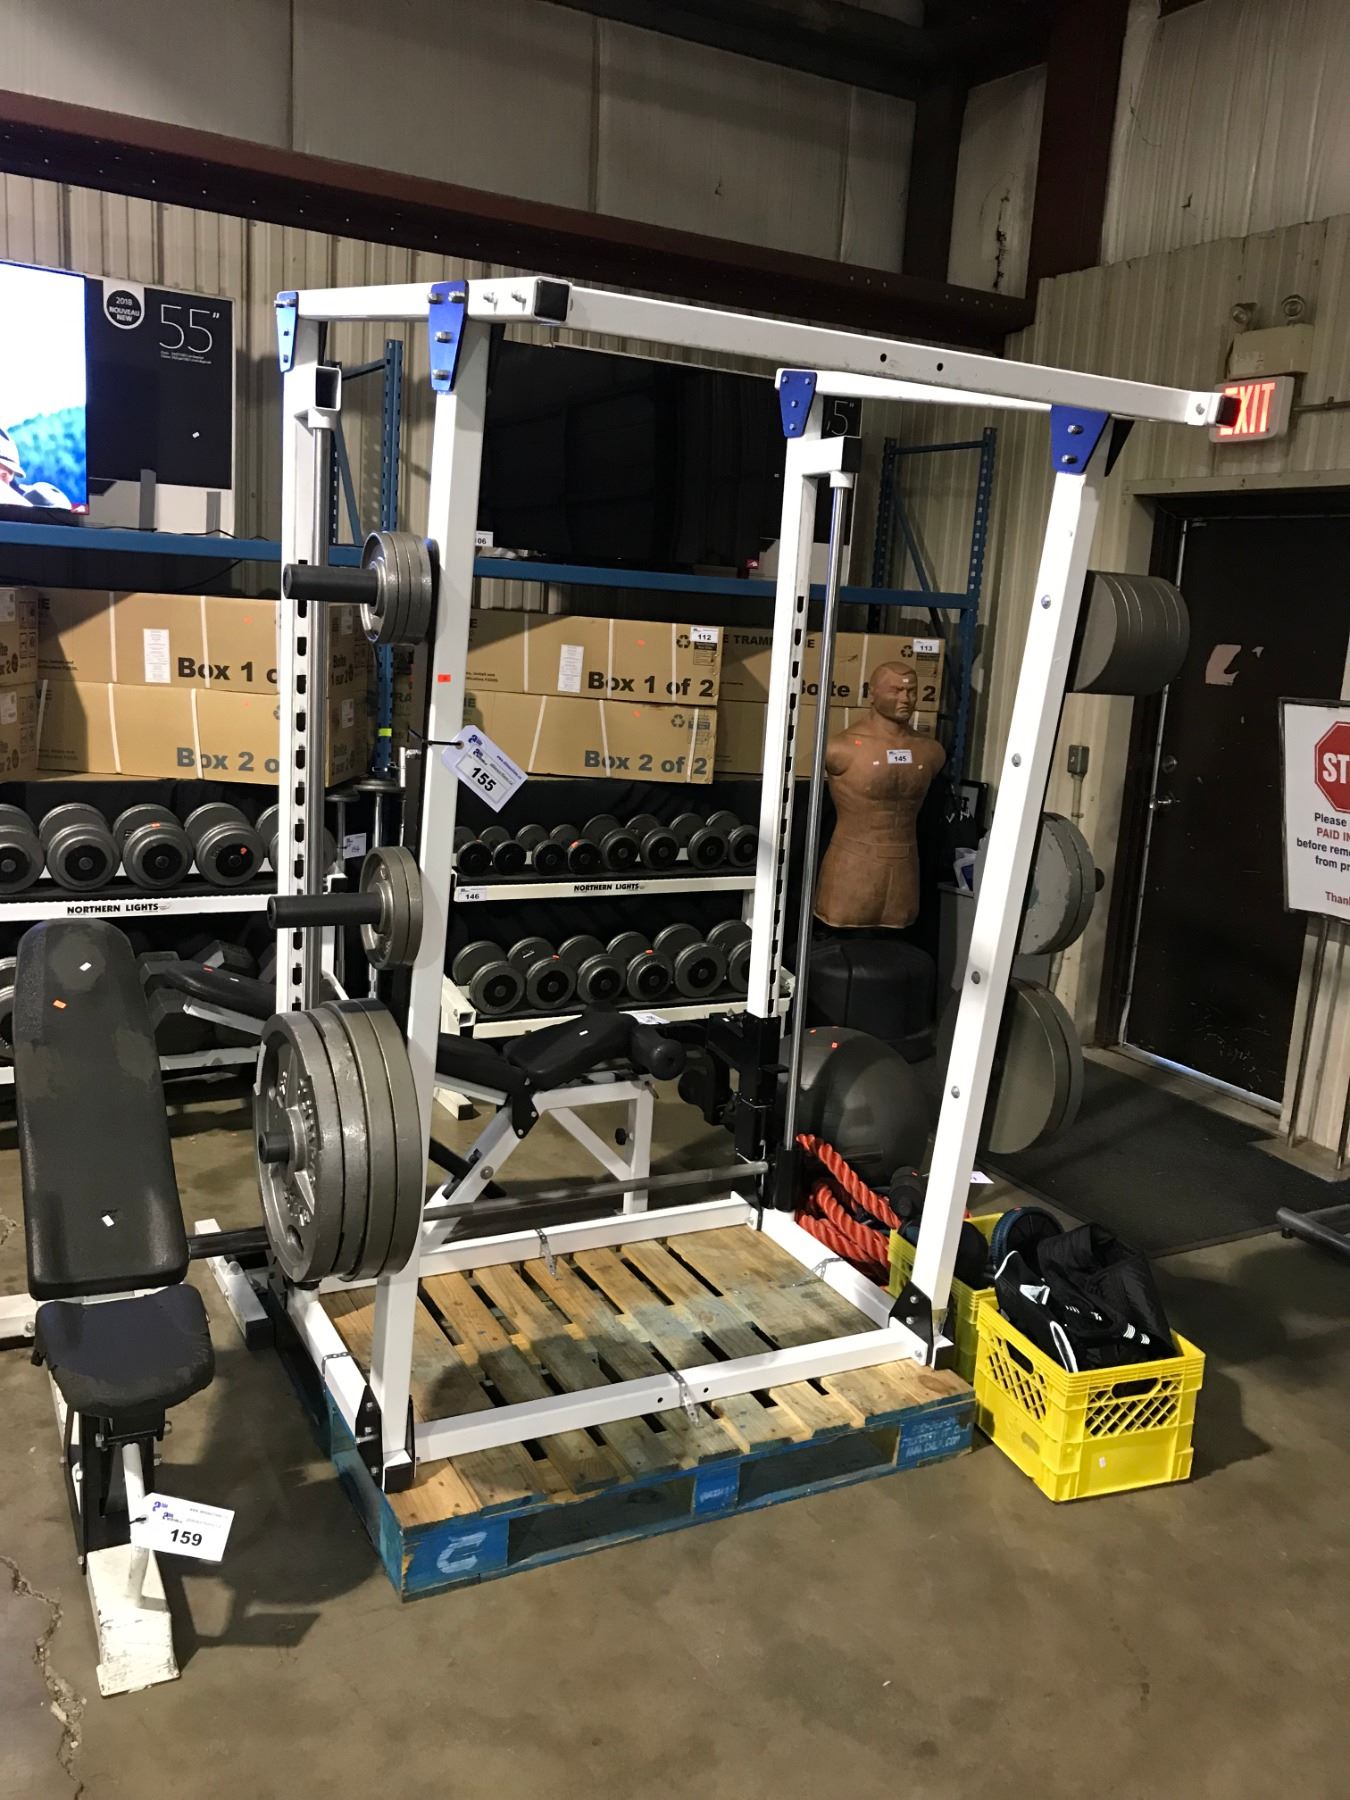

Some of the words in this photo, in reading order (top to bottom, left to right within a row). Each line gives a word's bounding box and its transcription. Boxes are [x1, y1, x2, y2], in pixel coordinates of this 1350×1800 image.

[115, 296, 133, 306] 2018
[109, 306, 140, 316] NOUVEAU
[116, 314, 132, 322] NEW
[475, 537, 487, 545] 06
[697, 633, 712, 641] 112
[178, 657, 231, 680] Box
[241, 661, 253, 682] 1
[588, 671, 635, 692] Box
[644, 676, 655, 694] 1
[666, 678, 692, 697] of
[698, 679, 714, 697] 2
[922, 684, 936, 702] 2
[176, 747, 228, 770] Box
[238, 752, 255, 772] 2
[584, 750, 630, 770] Box
[638, 754, 653, 772] 2
[661, 756, 686, 773] of
[693, 757, 708, 775] 2
[471, 767, 497, 792] 155
[1314, 812, 1347, 827] Please
[1316, 827, 1340, 840] PAID
[1297, 838, 1327, 852] before
[1315, 855, 1337, 868] from
[574, 884, 613, 892] NORTHERN
[615, 883, 640, 891] LIGHTS
[67, 905, 120, 914] NORTHERN
[125, 903, 159, 911] LIGHTS
[170, 1529, 203, 1547] 159
